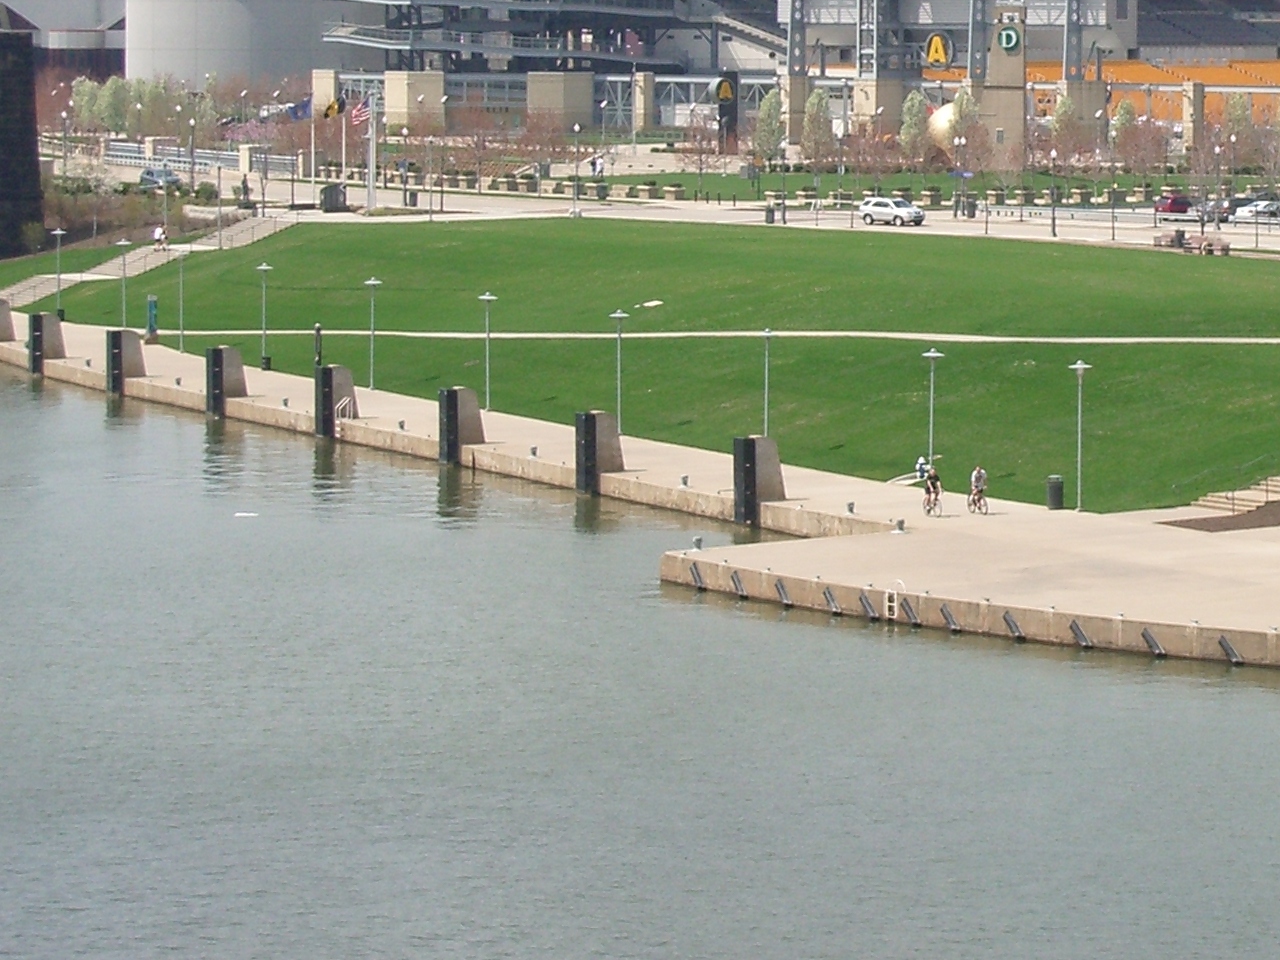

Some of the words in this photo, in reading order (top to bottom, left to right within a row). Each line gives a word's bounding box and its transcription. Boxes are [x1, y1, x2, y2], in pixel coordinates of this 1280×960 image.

[928, 35, 947, 63] A
[1001, 30, 1018, 49] D
[718, 81, 733, 100] A
